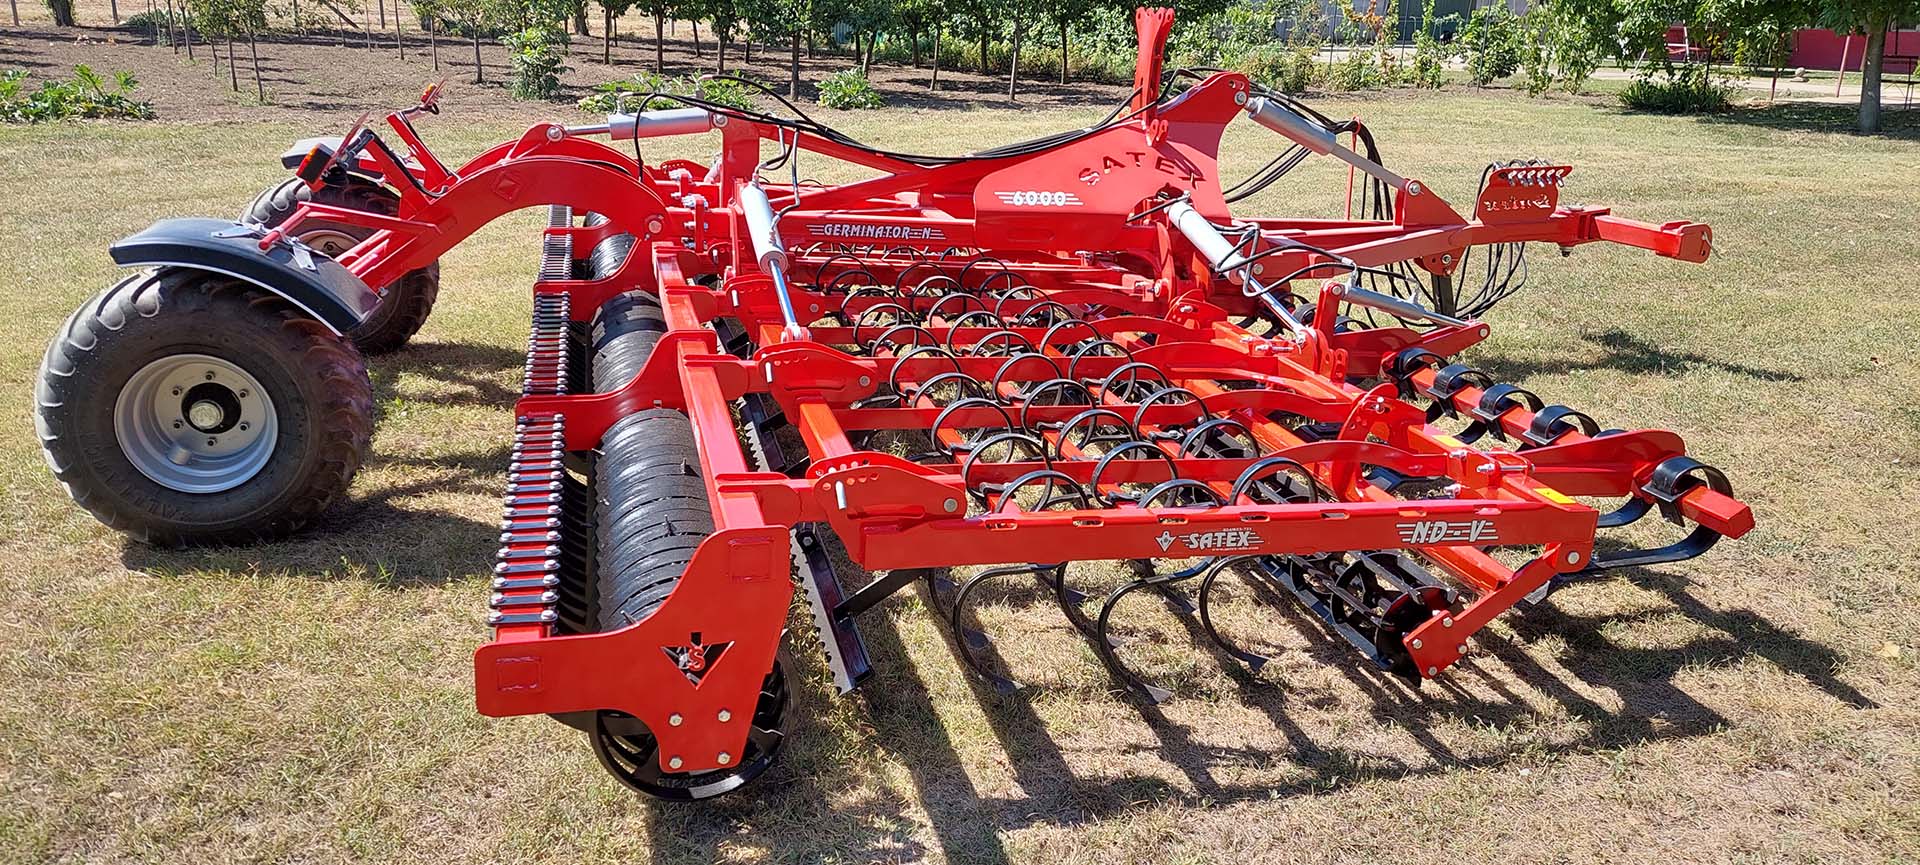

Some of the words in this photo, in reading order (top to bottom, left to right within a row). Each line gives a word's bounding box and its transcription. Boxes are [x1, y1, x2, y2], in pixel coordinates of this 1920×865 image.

[1079, 152, 1207, 190] SATEX
[1013, 191, 1066, 206] 6000
[1189, 531, 1250, 550] SATEX
